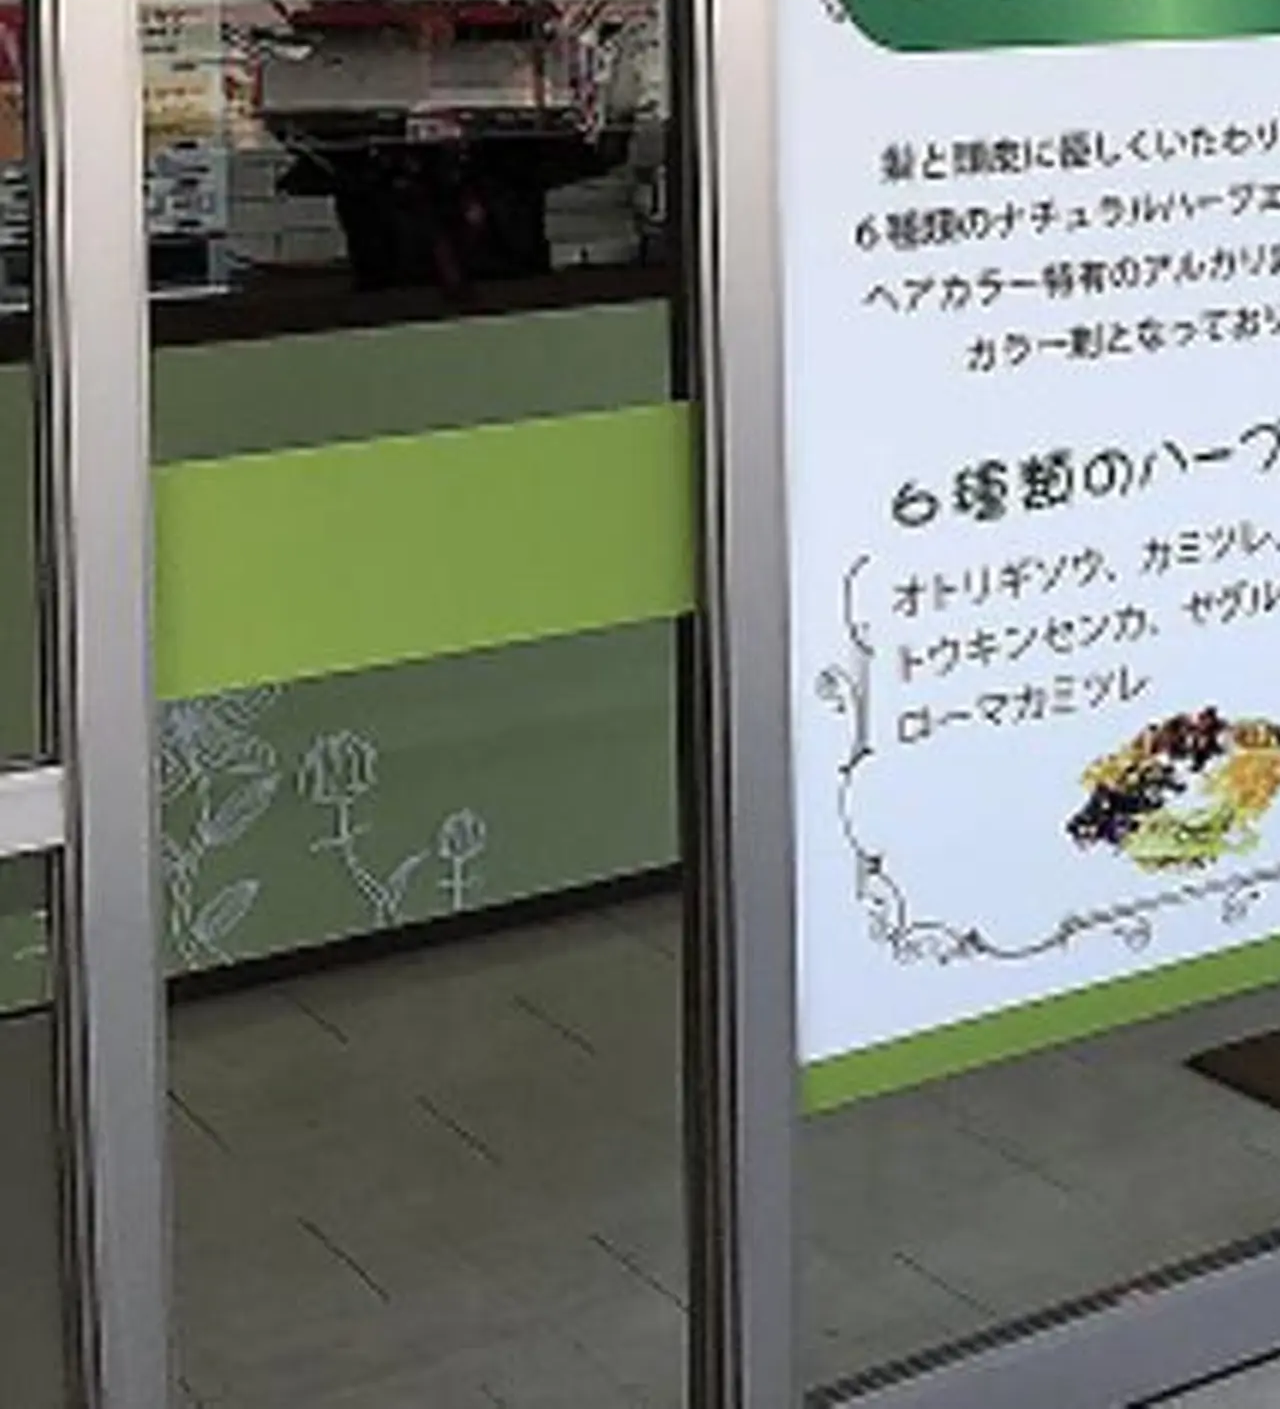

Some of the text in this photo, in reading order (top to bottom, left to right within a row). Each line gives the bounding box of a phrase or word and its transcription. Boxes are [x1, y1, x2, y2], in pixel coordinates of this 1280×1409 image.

[897, 663, 1151, 744] ローマカミツレ
